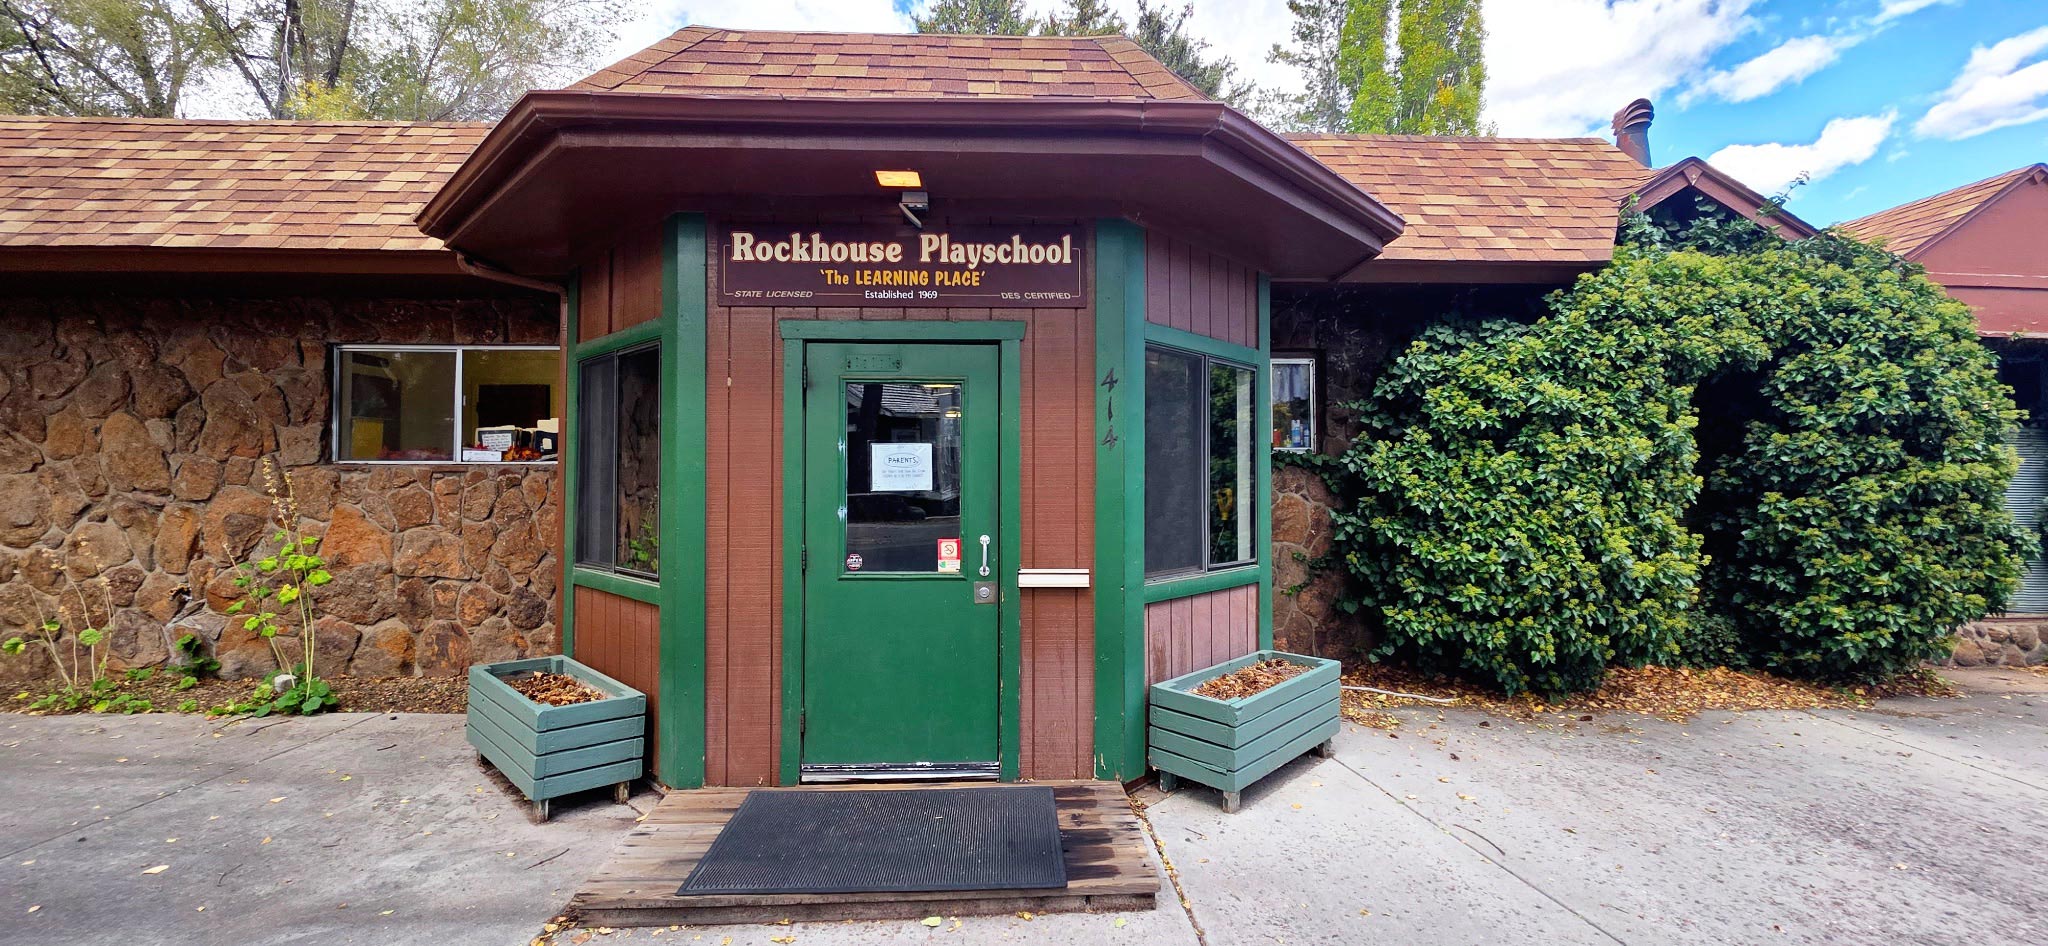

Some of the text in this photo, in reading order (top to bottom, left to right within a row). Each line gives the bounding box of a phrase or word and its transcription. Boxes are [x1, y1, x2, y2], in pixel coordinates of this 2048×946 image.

[731, 231, 1072, 270] Rockhouse Playschool
[855, 269, 929, 287] LEARNING
[734, 290, 813, 298] STATE LICENSED
[865, 290, 938, 299] Established 1969
[1001, 292, 1071, 300] DES CERTIFIED
[1101, 367, 1119, 452] 414
